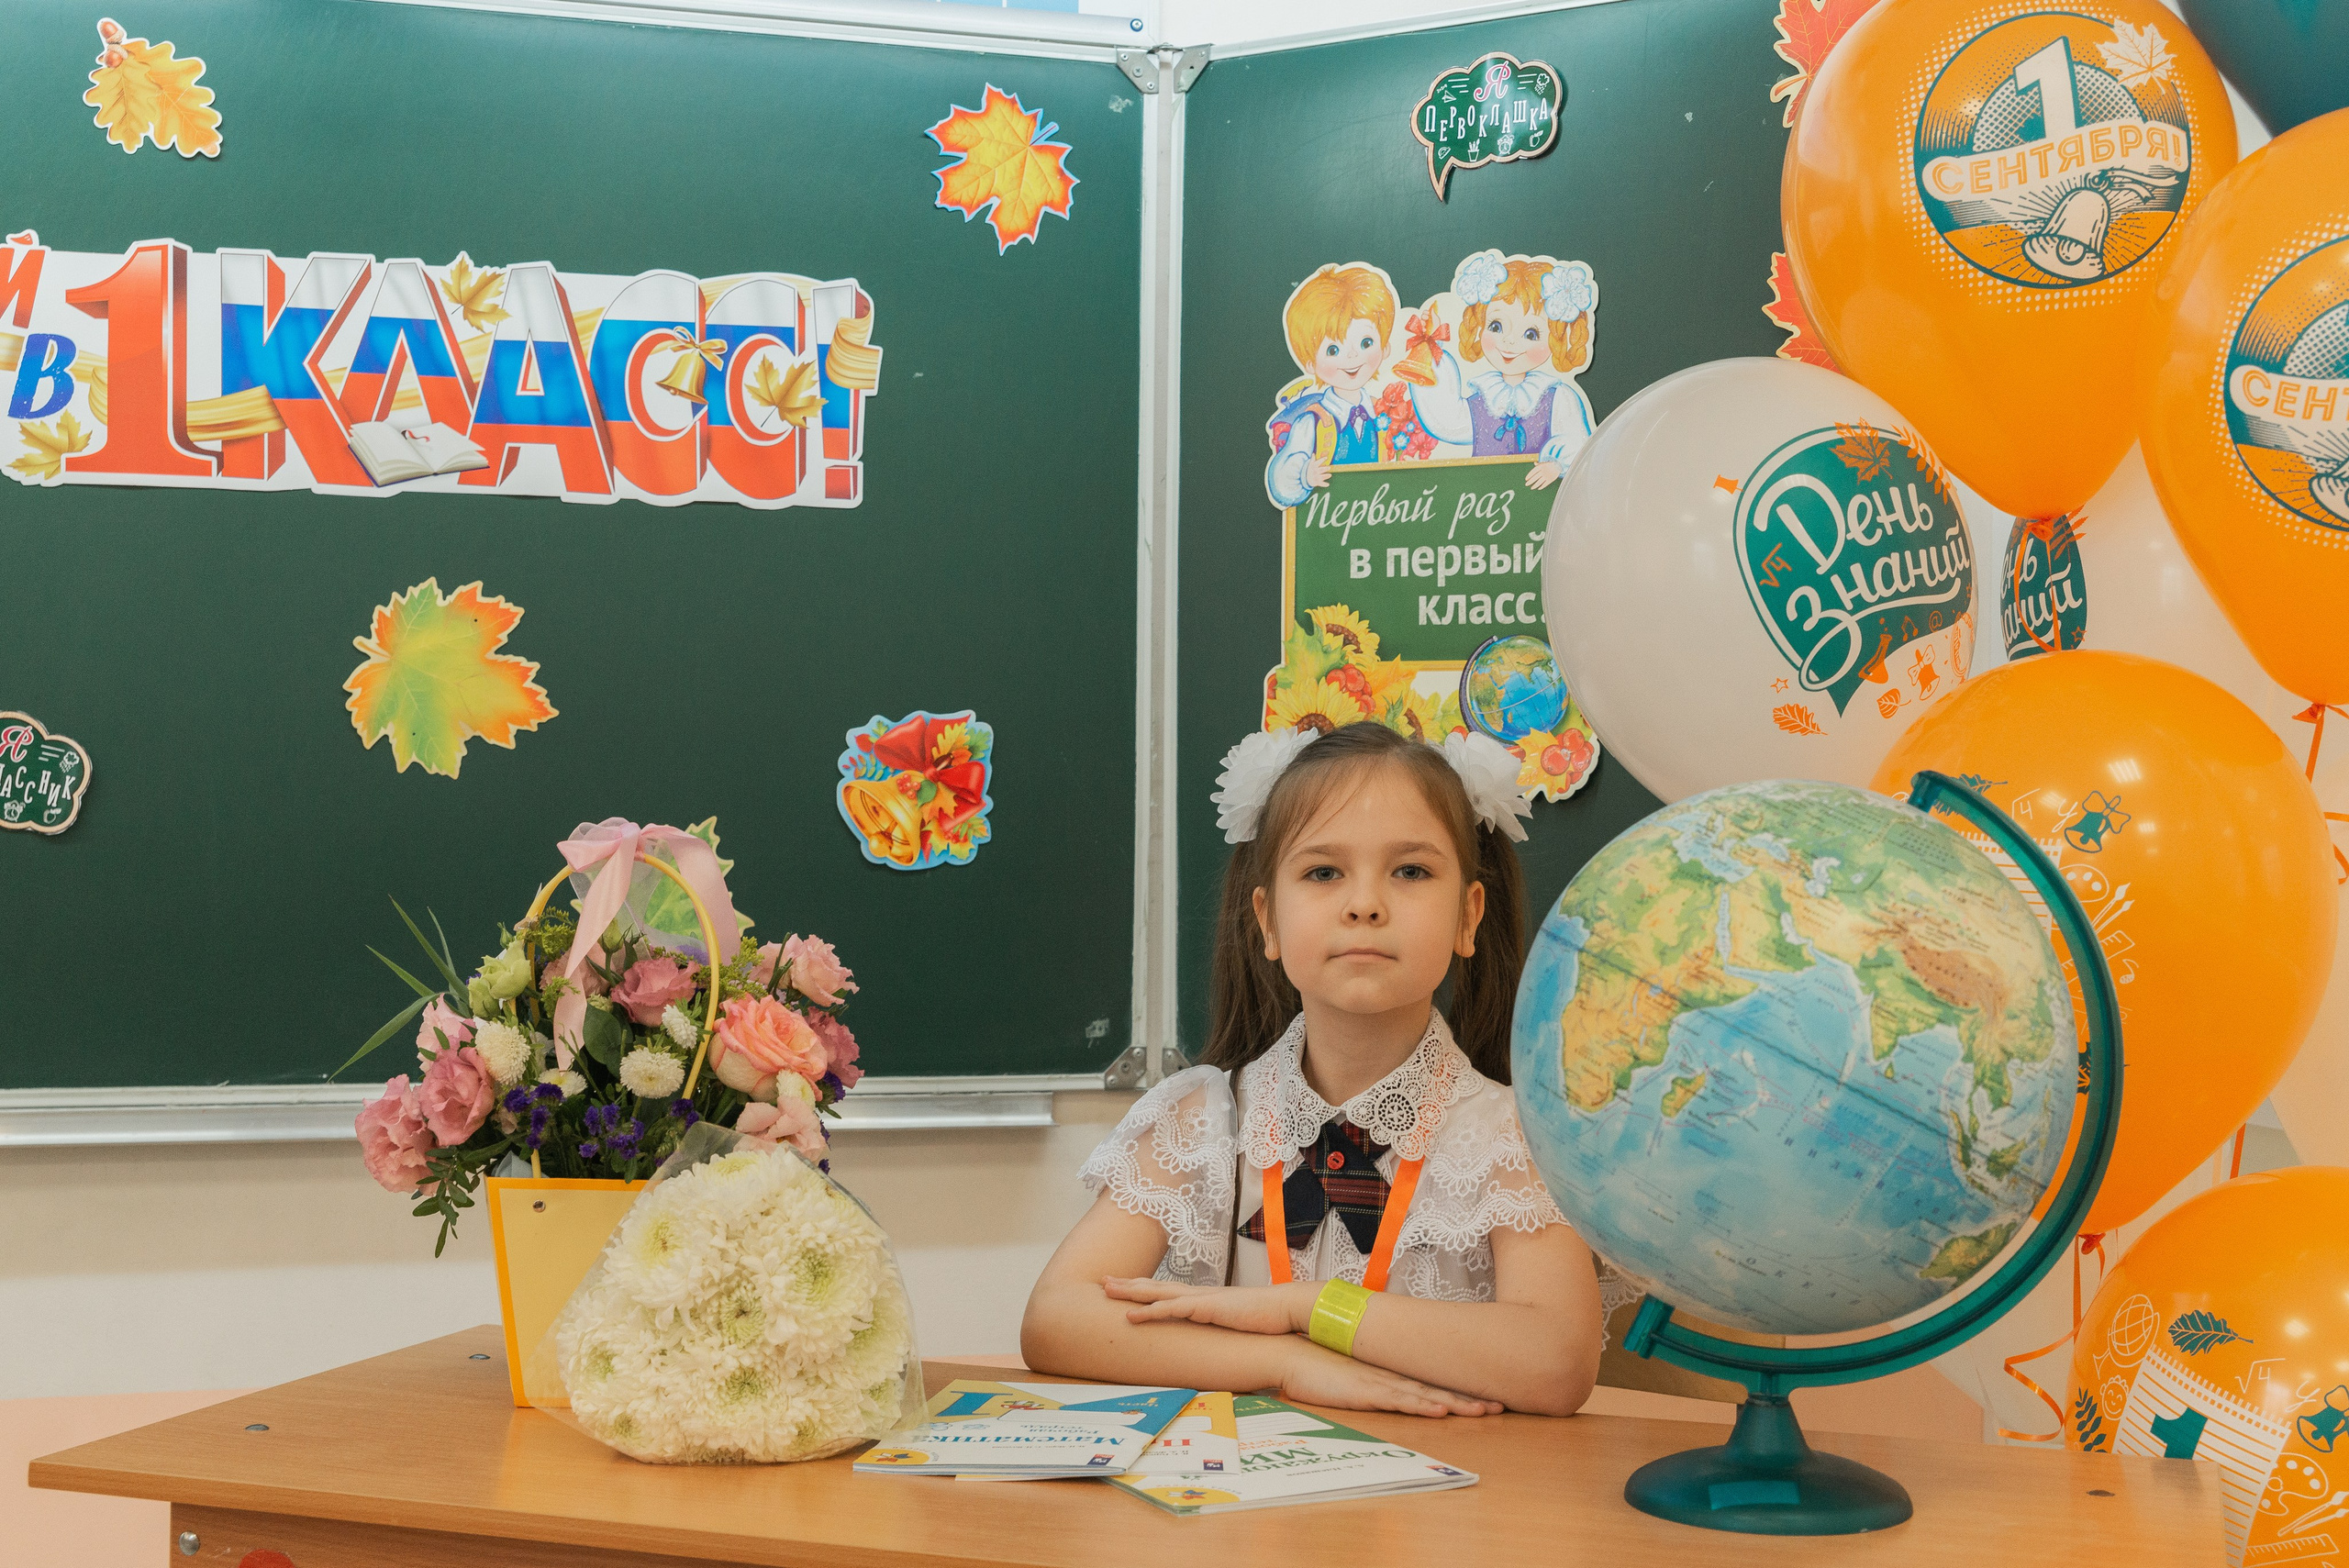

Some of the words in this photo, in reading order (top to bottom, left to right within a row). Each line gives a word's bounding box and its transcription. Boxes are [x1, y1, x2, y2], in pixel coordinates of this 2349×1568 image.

[1474, 61, 1511, 102] Я
[2014, 36, 2079, 139] 1
[1932, 125, 2182, 195] СЕНТЯБРЯ!
[65, 244, 224, 477] 1
[220, 252, 861, 500] КЛАСС!
[1304, 483, 1438, 546] Первый
[1448, 489, 1516, 540] раз
[1753, 473, 1933, 575] День
[1350, 548, 1373, 579] в
[1386, 531, 1545, 586] первый
[1786, 517, 1970, 691] Знаний
[1241, 1450, 1417, 1474] Окружаю
